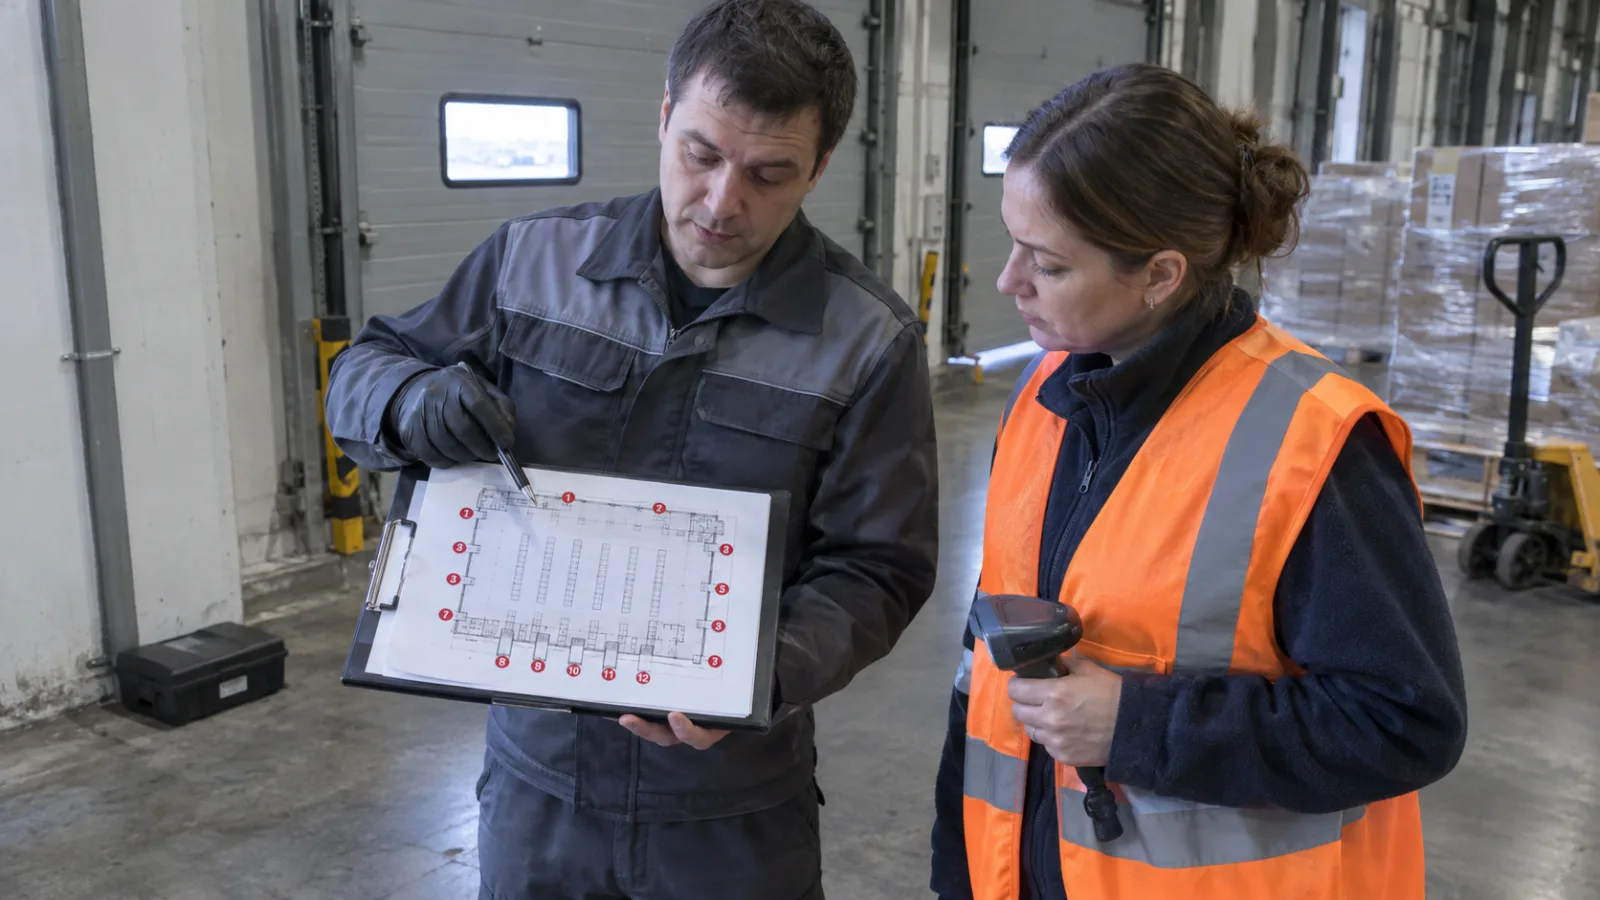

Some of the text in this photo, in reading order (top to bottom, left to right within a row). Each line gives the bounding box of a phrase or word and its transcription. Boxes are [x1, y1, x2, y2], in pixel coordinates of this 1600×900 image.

[450, 575, 457, 583] 3
[712, 657, 719, 666] 3
[569, 666, 580, 675] 10
[604, 670, 614, 679] 11
[638, 673, 649, 683] 12
